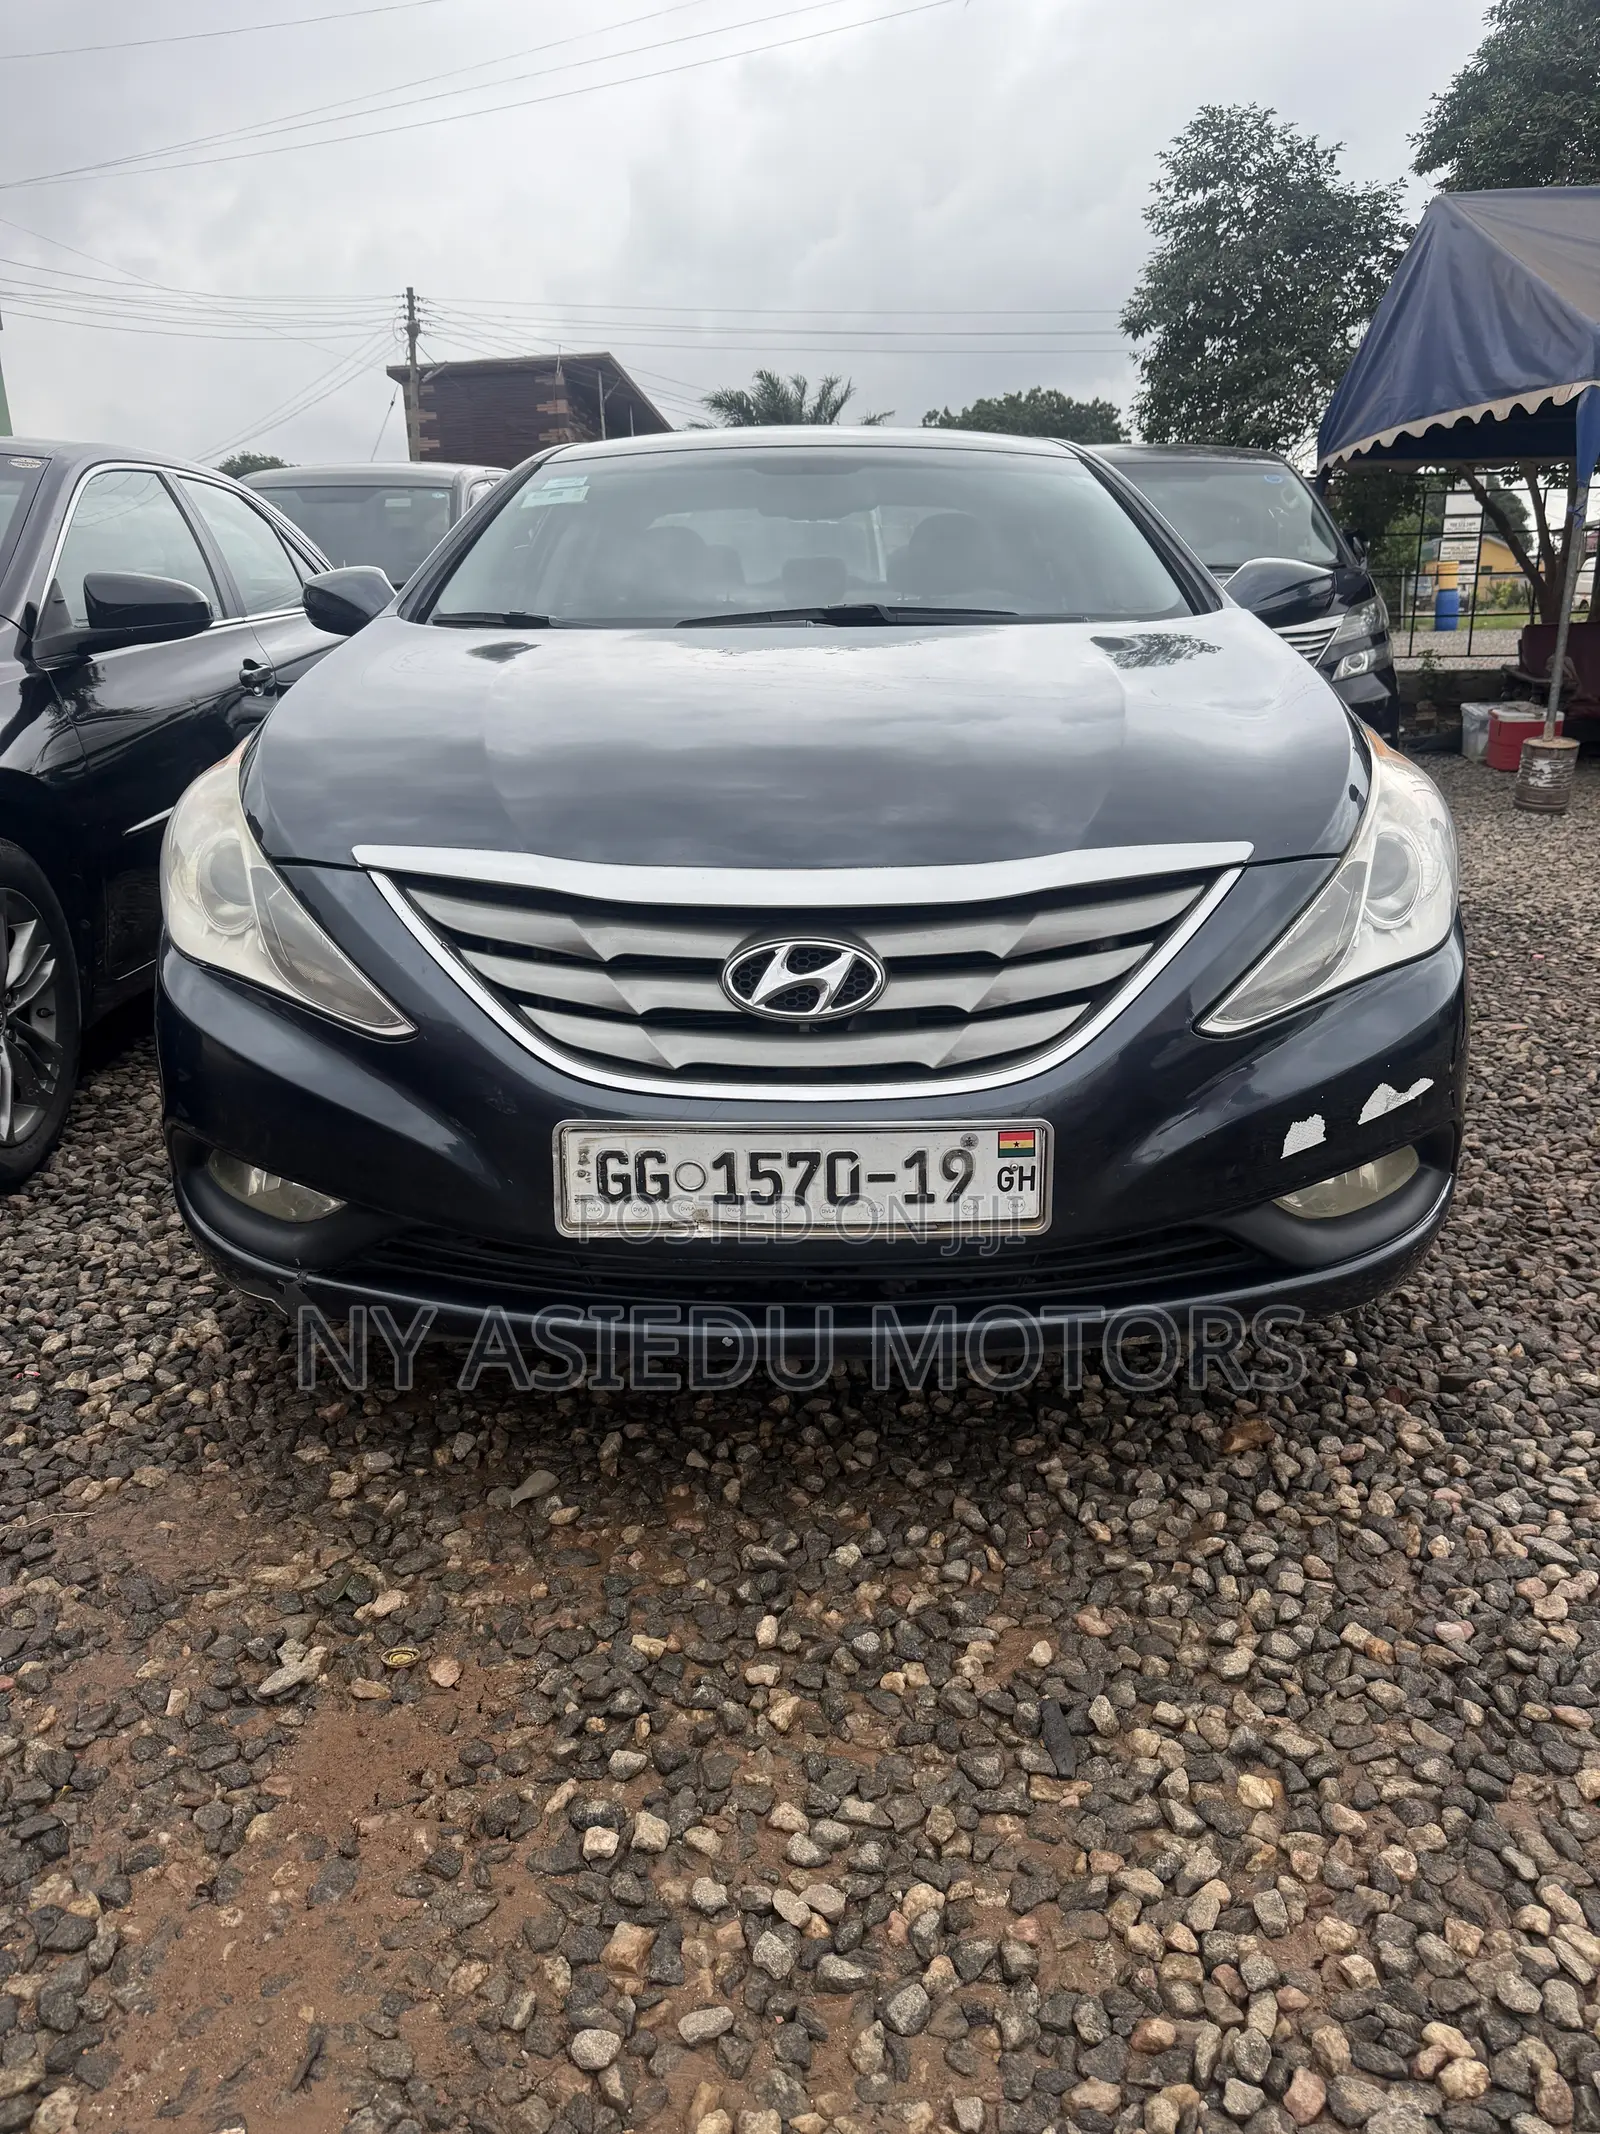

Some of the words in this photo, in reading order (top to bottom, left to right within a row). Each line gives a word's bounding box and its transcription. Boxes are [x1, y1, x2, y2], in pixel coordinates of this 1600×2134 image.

[596, 1149, 670, 1202] GG
[711, 1149, 976, 1206] 1570-19
[997, 1164, 1036, 1192] GH
